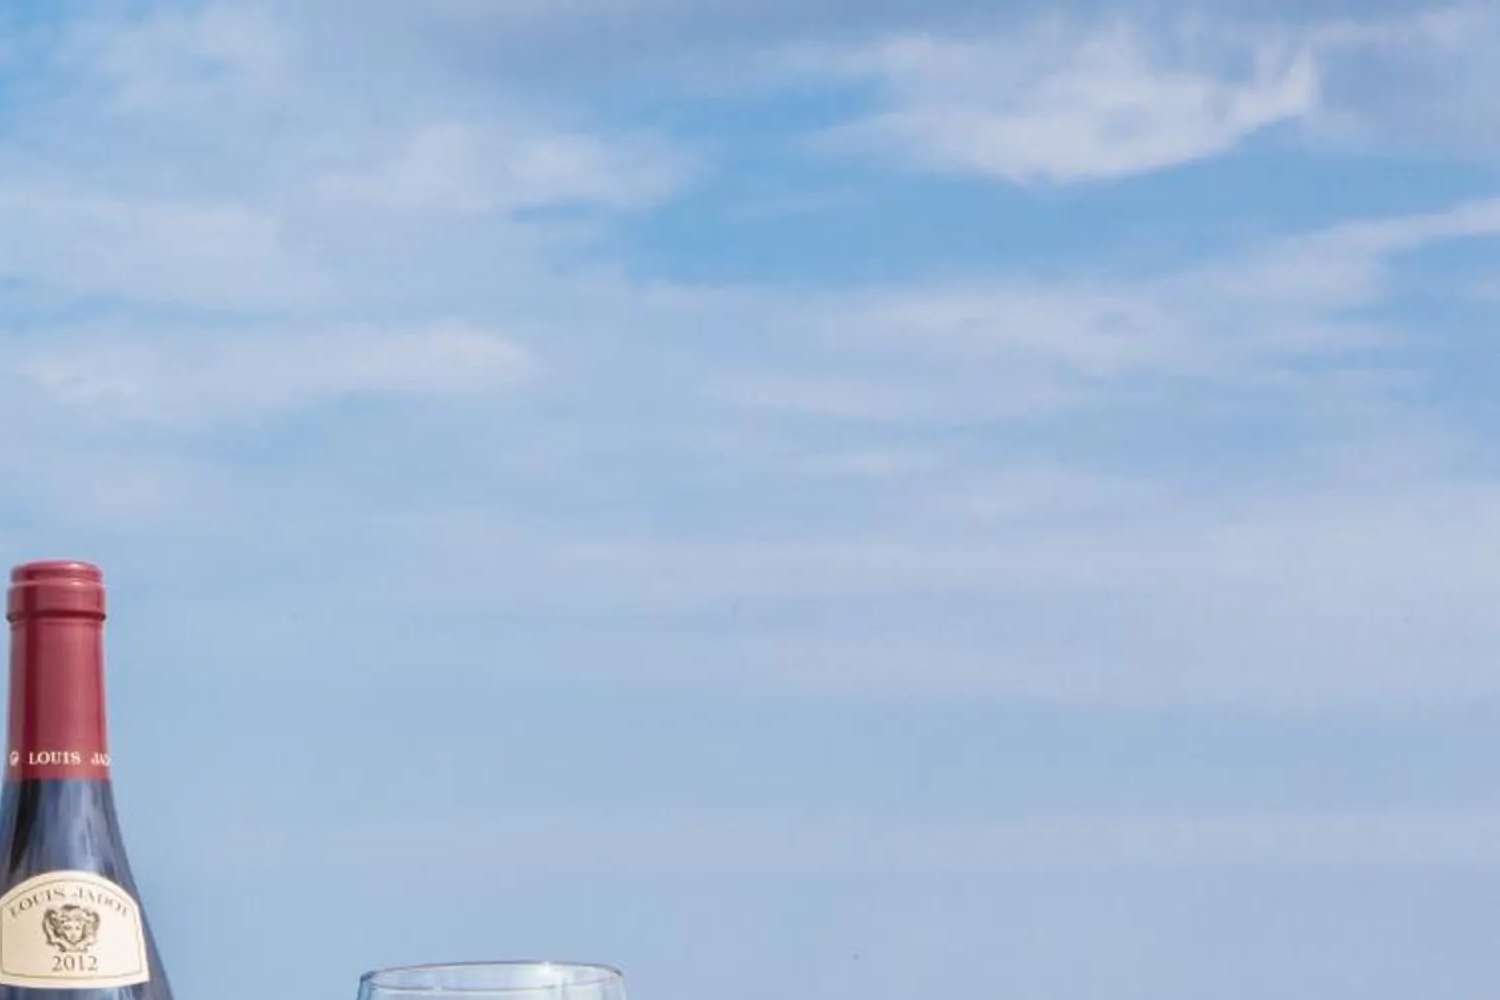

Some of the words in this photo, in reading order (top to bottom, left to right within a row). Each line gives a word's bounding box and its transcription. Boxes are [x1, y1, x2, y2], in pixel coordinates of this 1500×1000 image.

[28, 750, 81, 766] LOUIS
[9, 886, 65, 918] LOUIS
[72, 886, 127, 917] JADOT
[51, 954, 98, 972] 2012
